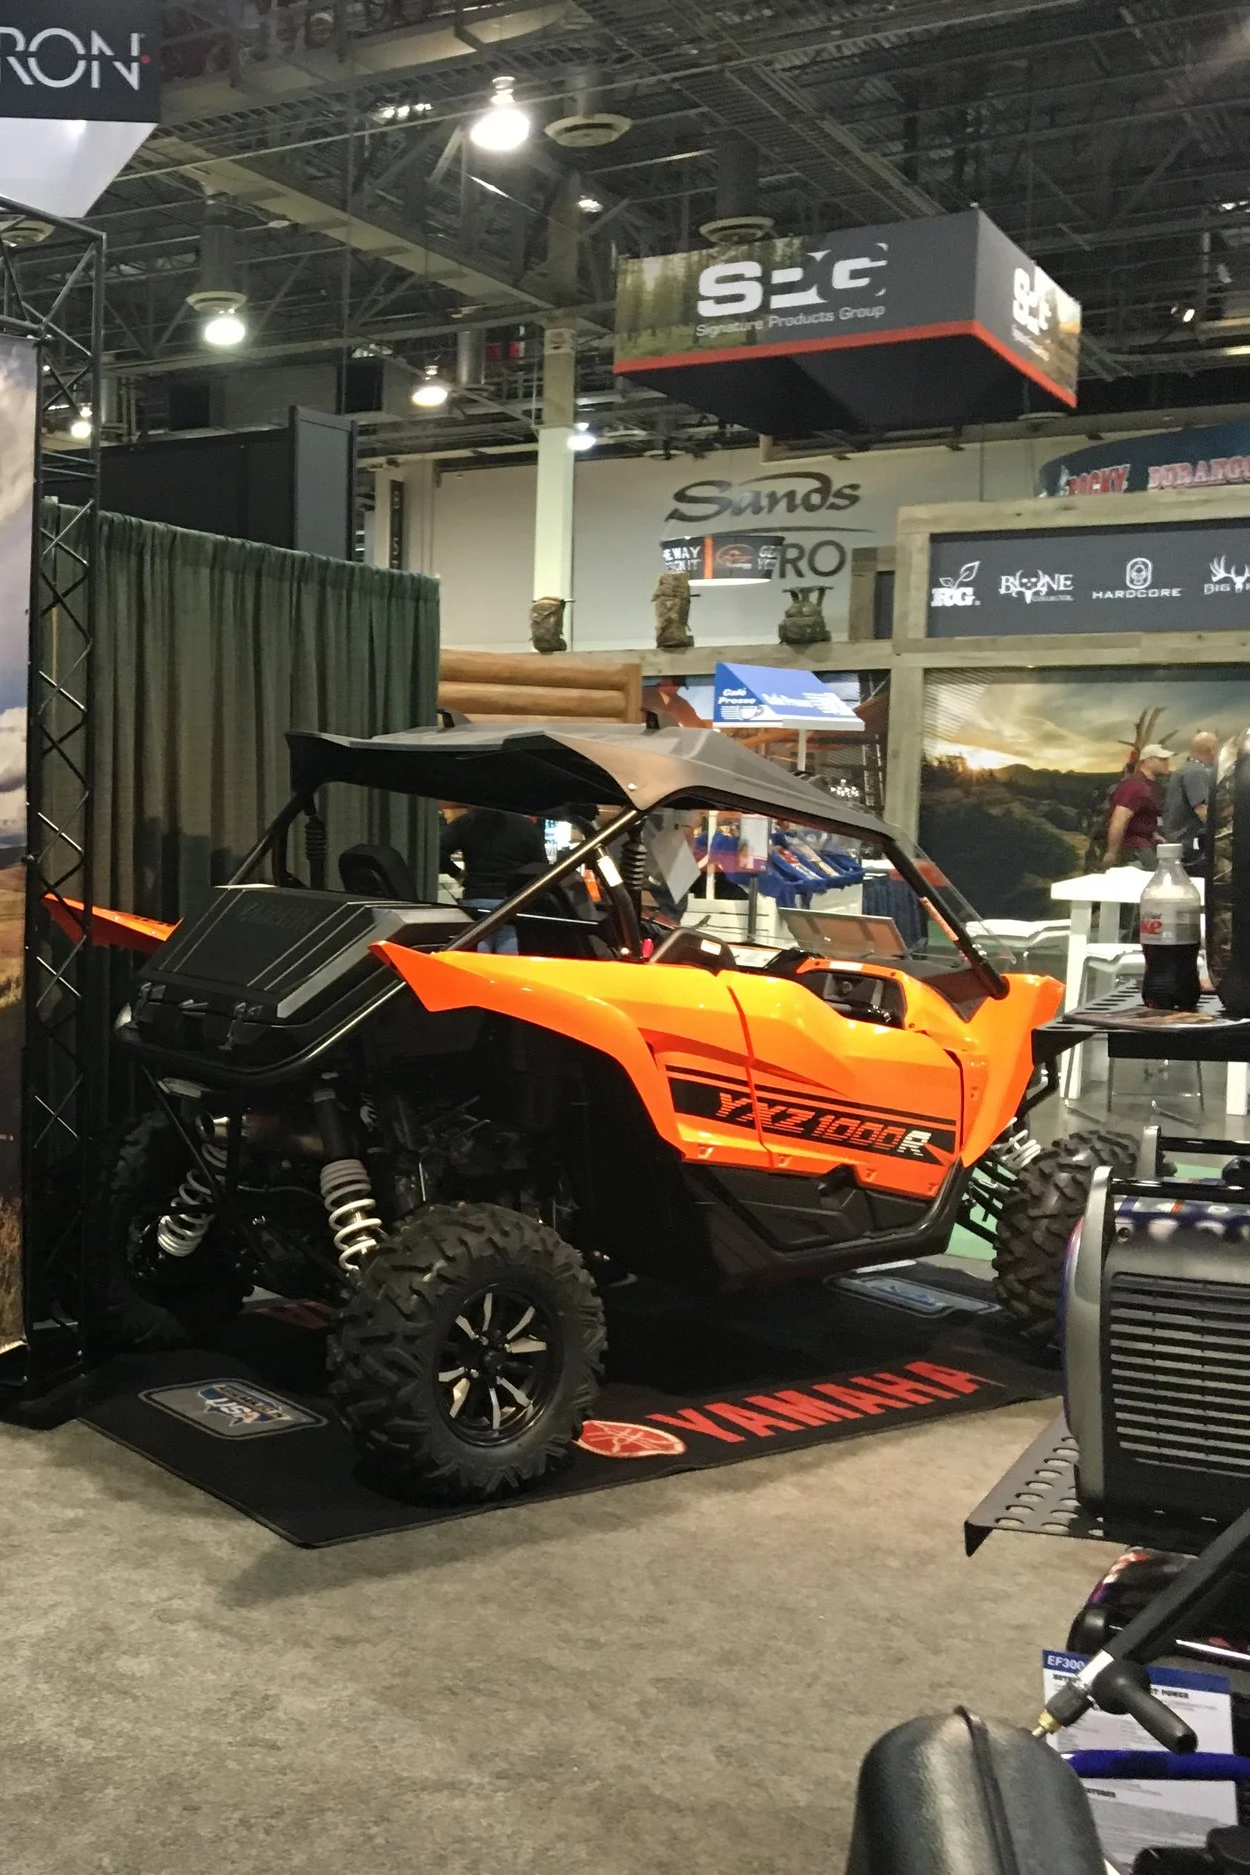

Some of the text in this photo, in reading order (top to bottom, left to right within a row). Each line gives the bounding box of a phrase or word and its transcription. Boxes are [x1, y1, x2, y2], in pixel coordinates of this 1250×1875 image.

[695, 303, 886, 338] Signature Products Group
[663, 471, 862, 523] Sands
[779, 539, 847, 579] RO
[1091, 587, 1184, 599] HARDCORE
[1204, 582, 1231, 596] BIG
[645, 1360, 1008, 1444] YAMAHA
